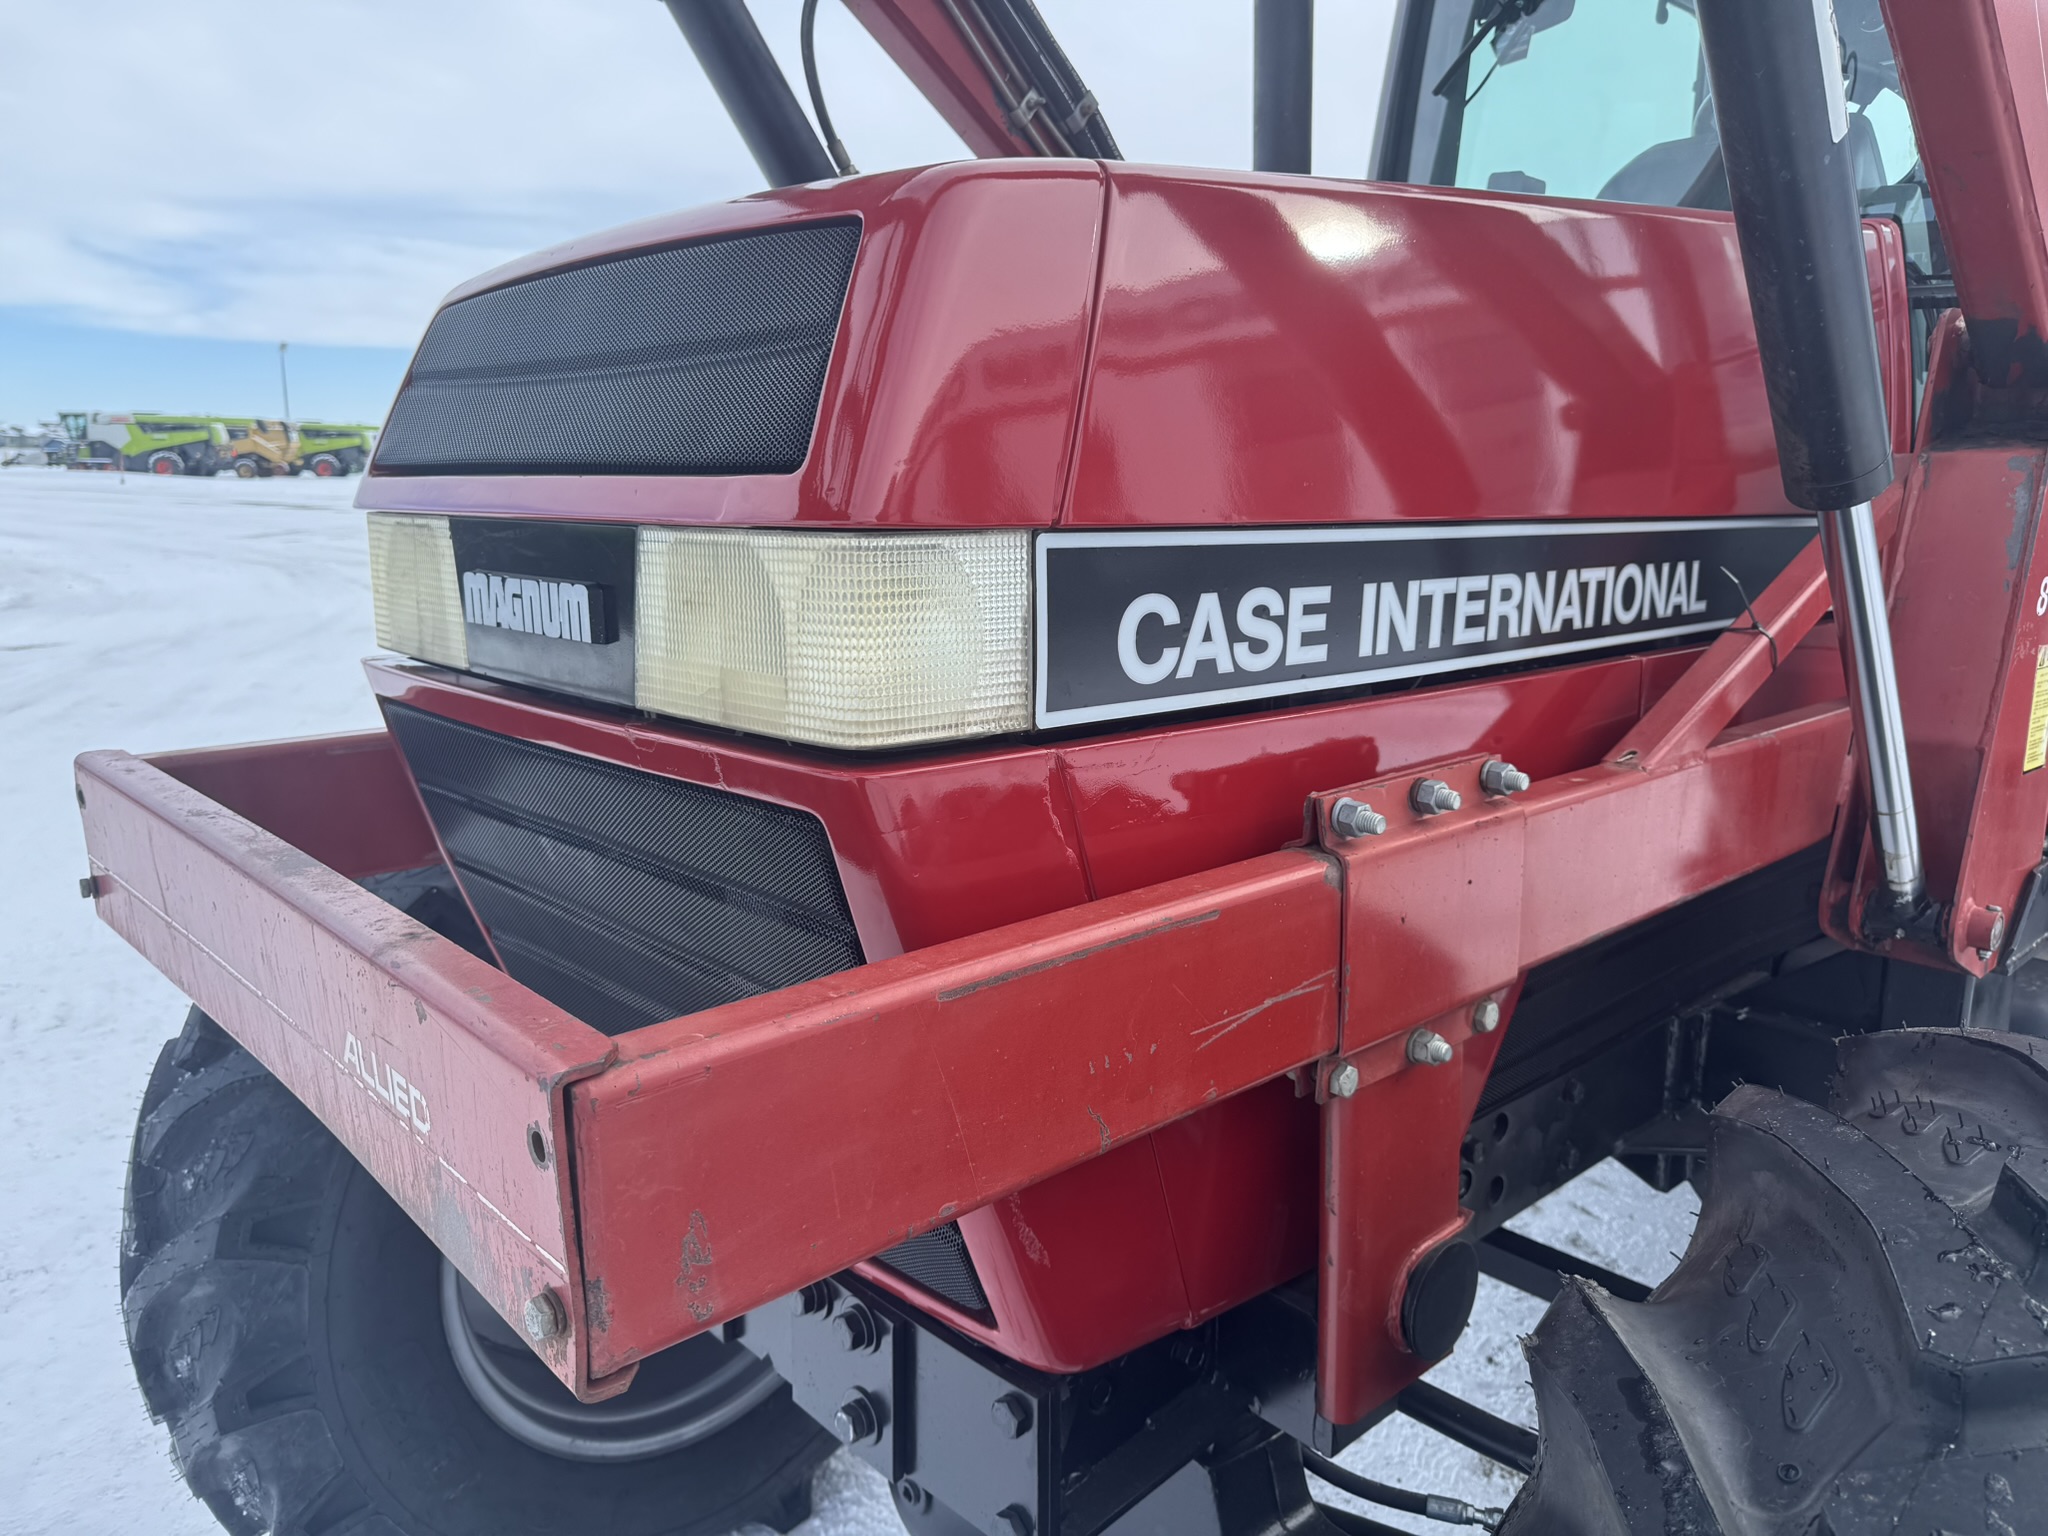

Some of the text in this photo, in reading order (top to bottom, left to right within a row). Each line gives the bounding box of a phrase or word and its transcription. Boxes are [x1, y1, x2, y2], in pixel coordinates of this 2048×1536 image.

[463, 571, 592, 644] MAGNUM
[1117, 560, 1707, 685] CASE INTERNATIONAL
[343, 1030, 431, 1136] ALLIED
